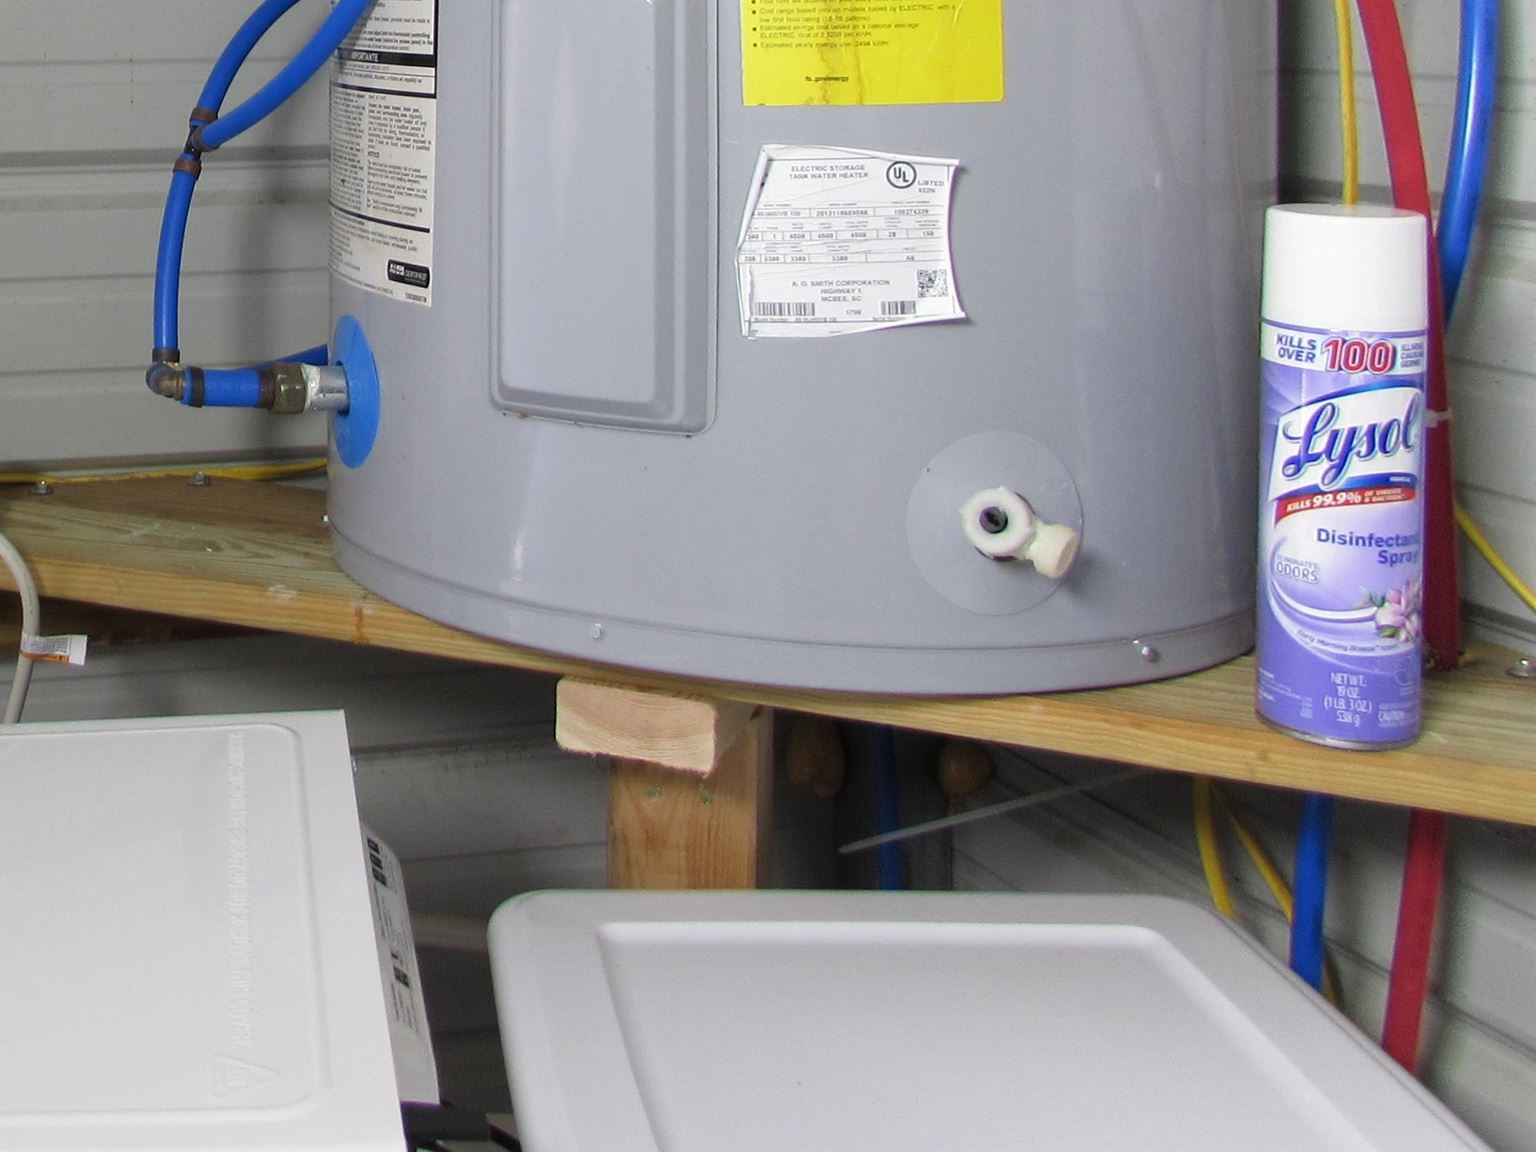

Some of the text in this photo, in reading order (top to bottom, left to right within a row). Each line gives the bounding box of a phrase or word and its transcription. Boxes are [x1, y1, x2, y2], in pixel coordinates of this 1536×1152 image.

[789, 172, 808, 180] TANK
[838, 171, 869, 179] HEATER
[791, 164, 866, 173] ELECTRIC STORAGE
[835, 279, 891, 287] CORPORATION
[1275, 333, 1317, 351] KILLS
[1277, 346, 1317, 364] OVER
[1320, 336, 1395, 376] 100
[1281, 392, 1424, 488] Lysol
[1286, 491, 1362, 512] KILLS 99.9%
[1275, 561, 1319, 583] ODORS
[1331, 672, 1348, 686] NET
